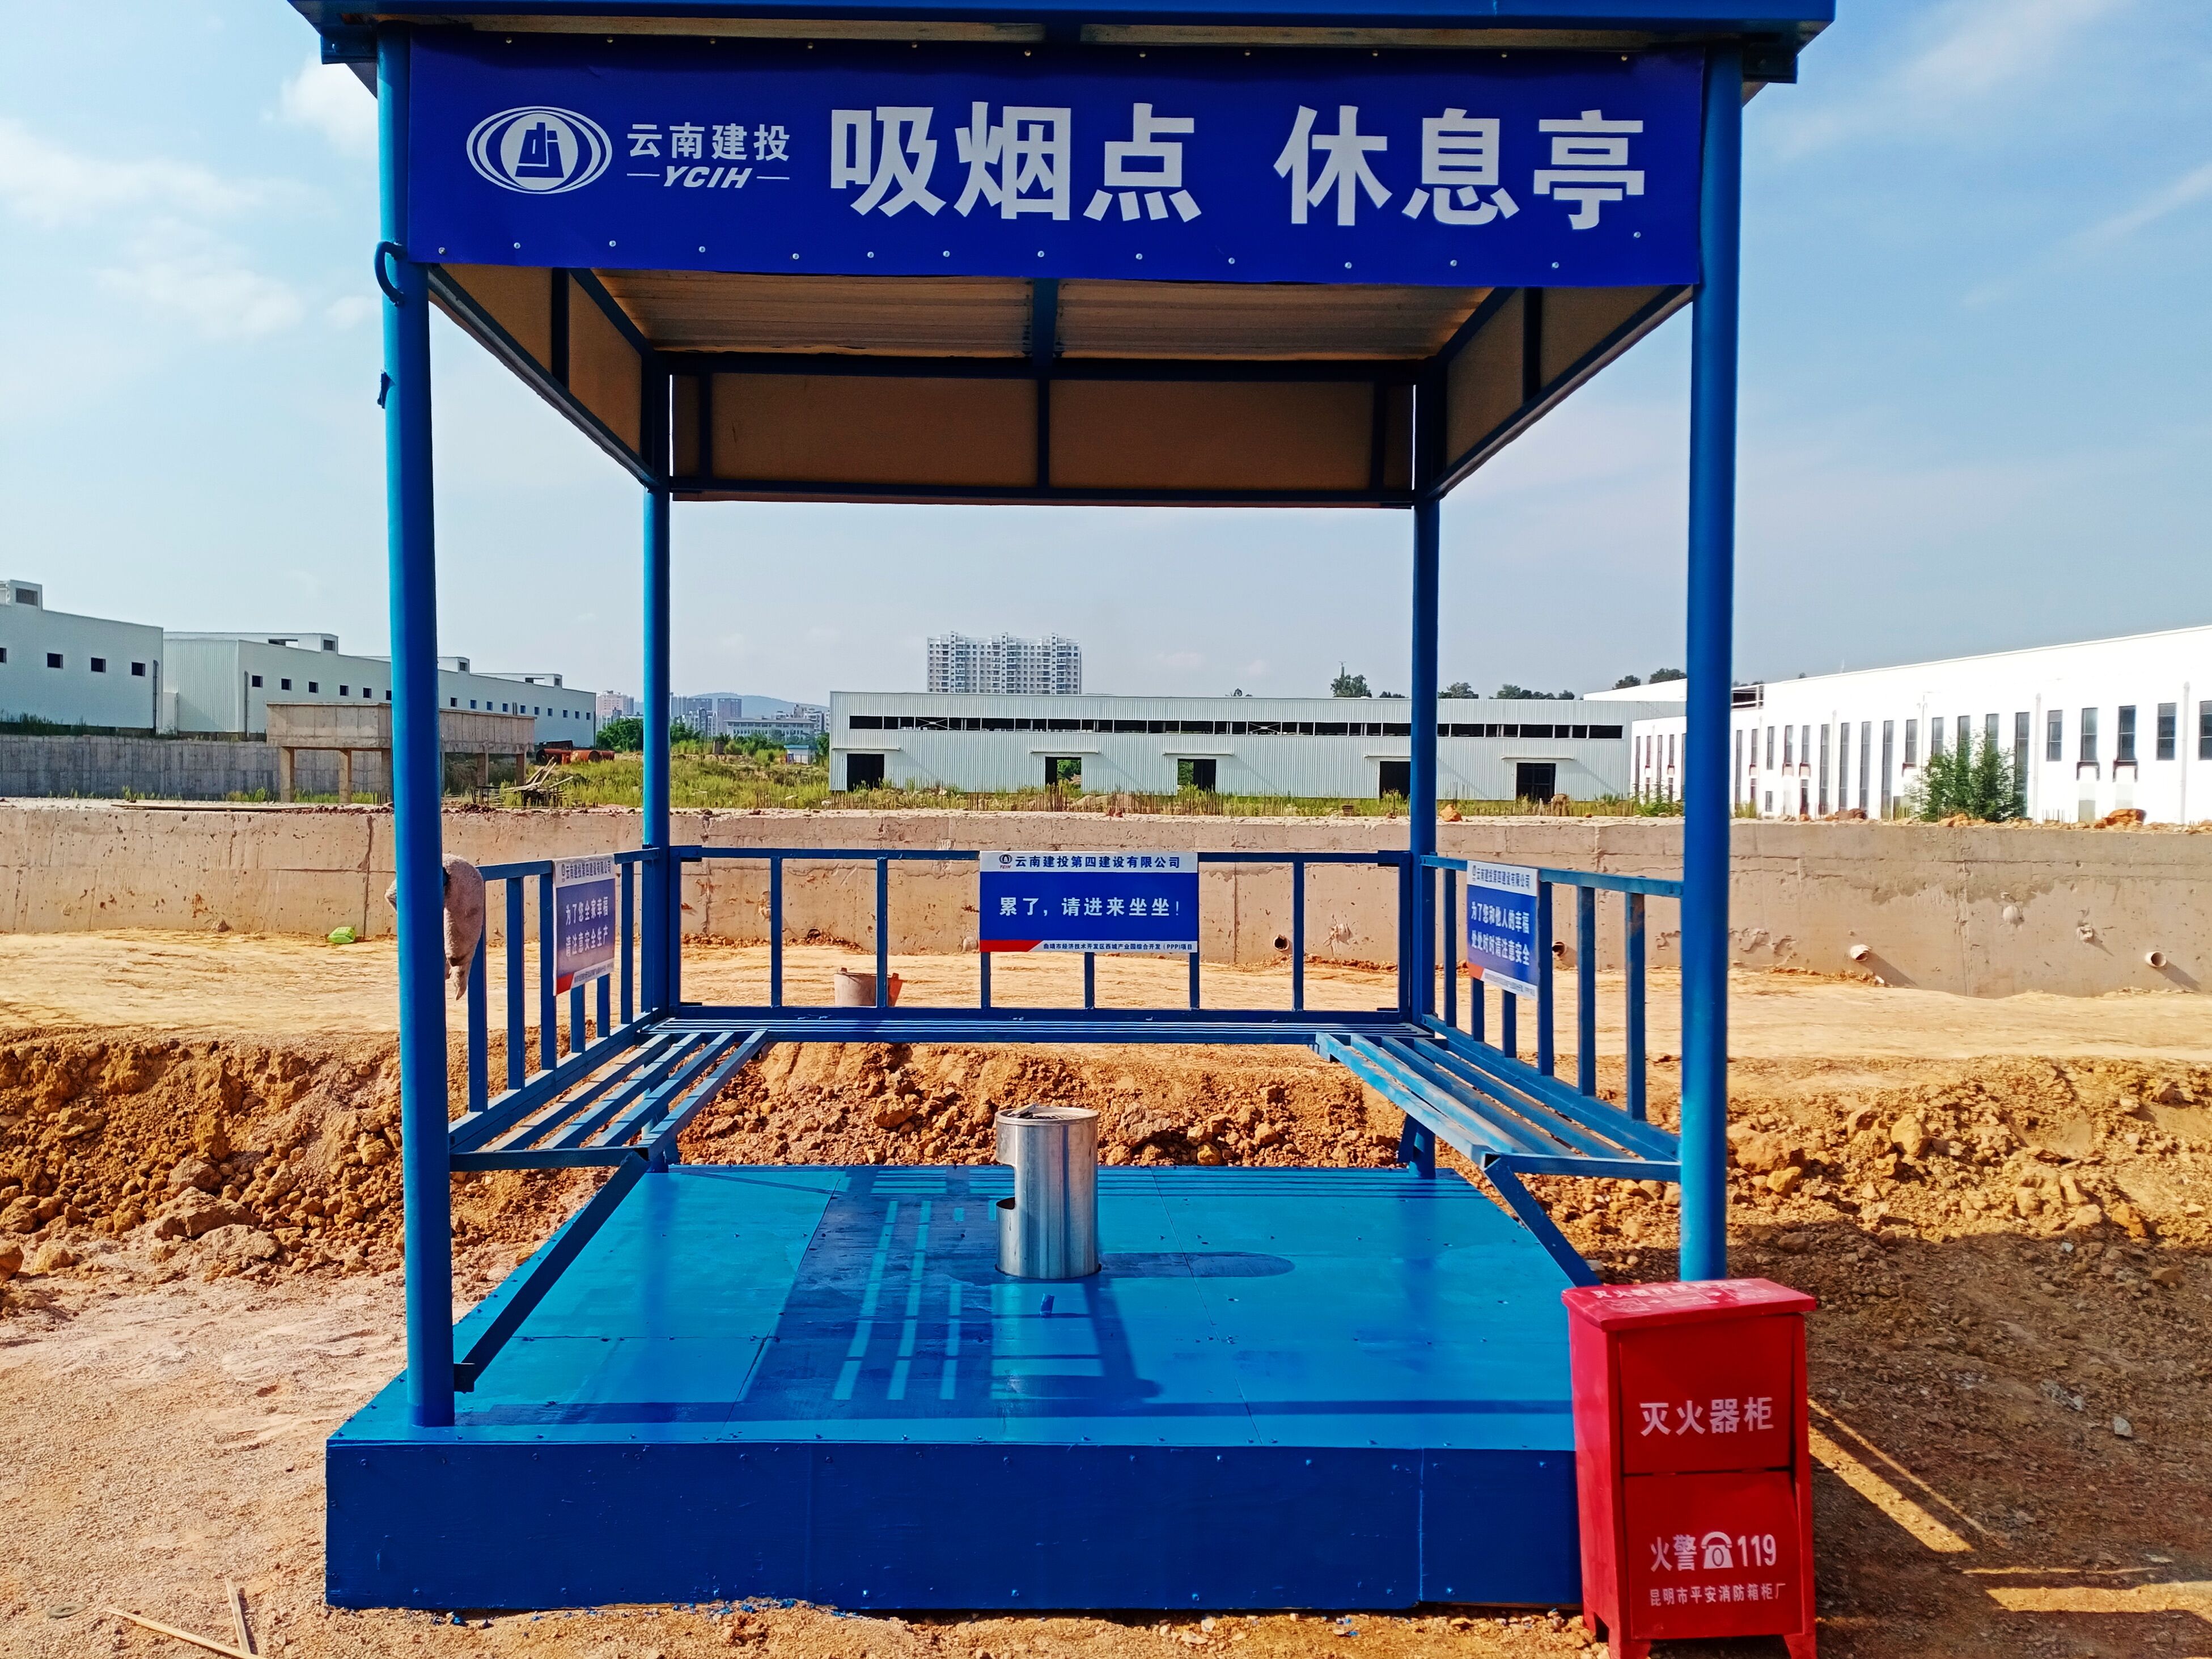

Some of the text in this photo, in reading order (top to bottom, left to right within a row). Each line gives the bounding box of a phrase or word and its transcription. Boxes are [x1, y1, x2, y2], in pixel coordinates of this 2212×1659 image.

[626, 122, 790, 162] 云南建投
[663, 166, 752, 189] YCIH
[830, 101, 1645, 230] 吸烟点 休息亭
[1015, 855, 1180, 869] 云南建投第四建设有限公司
[566, 896, 608, 925] 为了您全家幸福
[1471, 901, 1529, 934] 为了您和他人的幸福
[566, 925, 608, 957] 请注意安全生产
[1639, 1396, 1774, 1437] 灭火器柜
[1650, 1534, 1777, 1572] 火警 119
[1650, 1582, 1786, 1606] 昆明市平安消防箱柜厂
